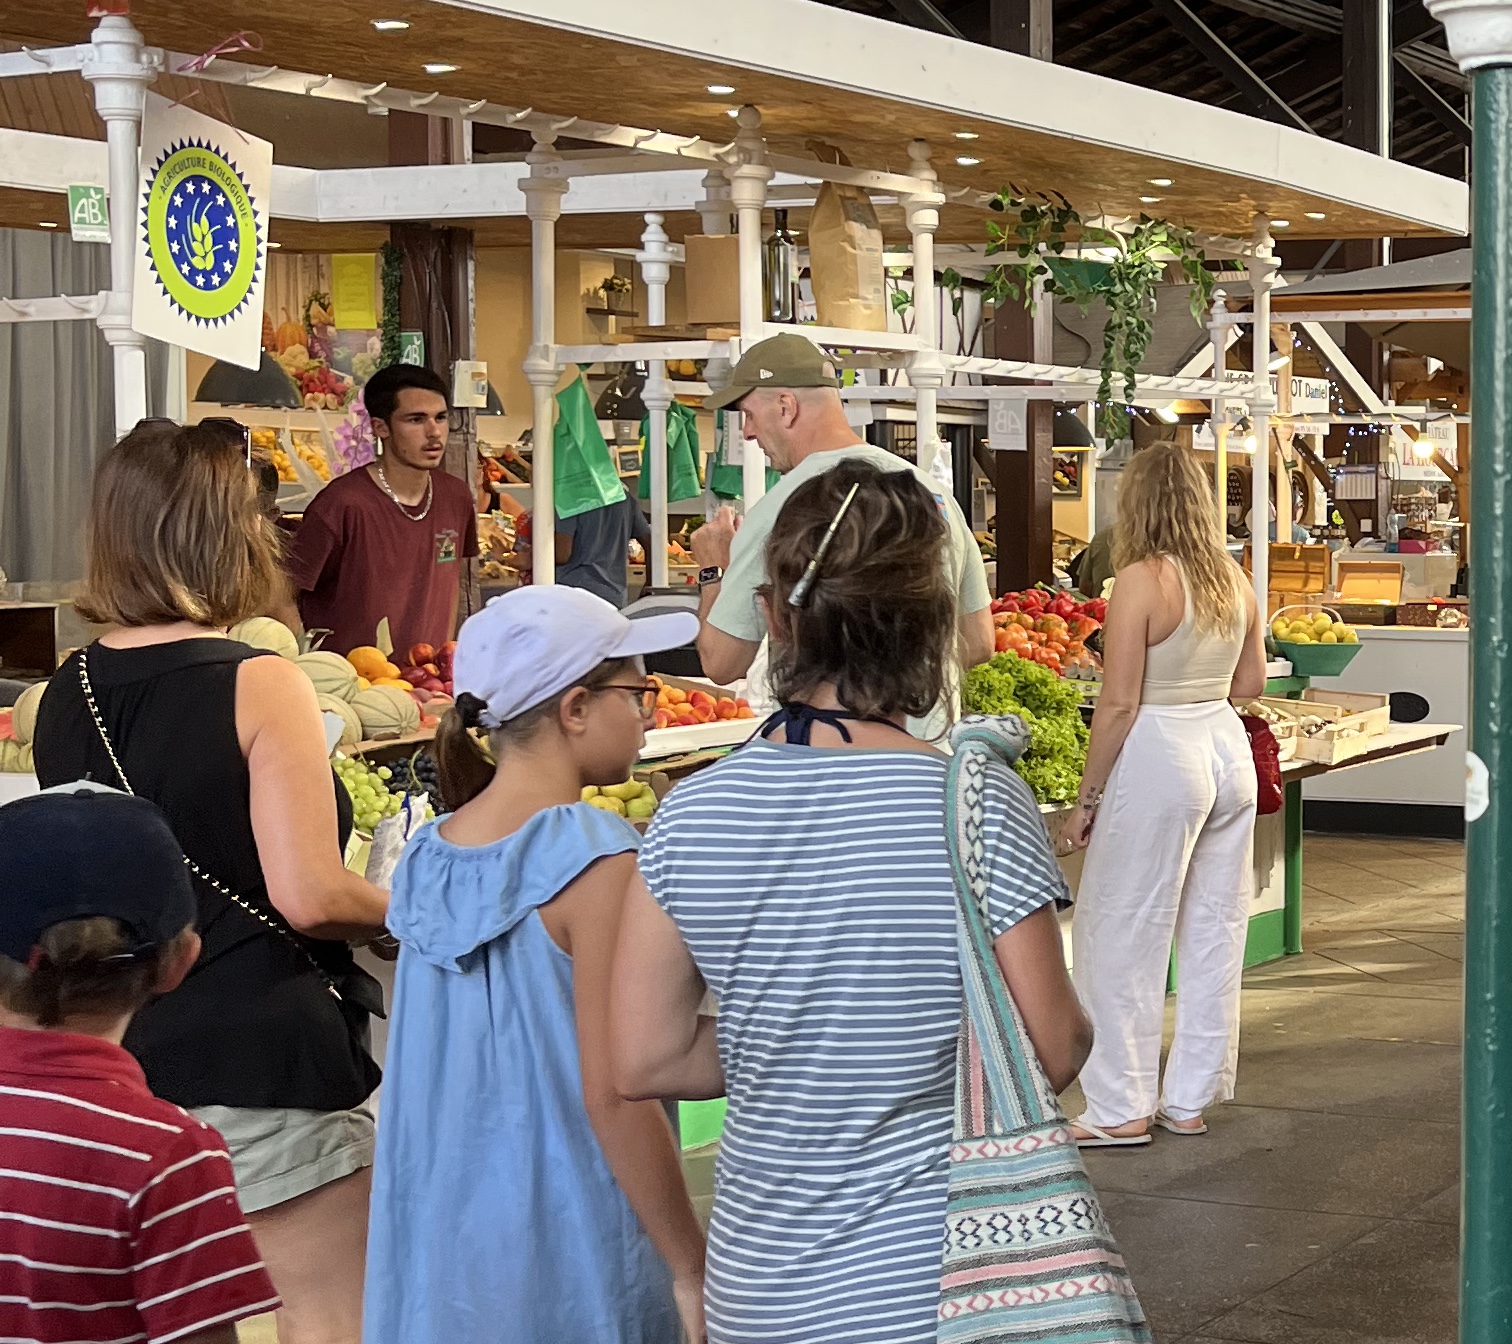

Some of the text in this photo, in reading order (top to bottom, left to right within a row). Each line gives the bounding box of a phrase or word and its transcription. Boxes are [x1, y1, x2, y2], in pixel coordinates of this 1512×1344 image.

[160, 157, 250, 220] AGRICULTURE BIOLOGIQUE
[74, 197, 102, 225] AB
[401, 344, 420, 366] AB
